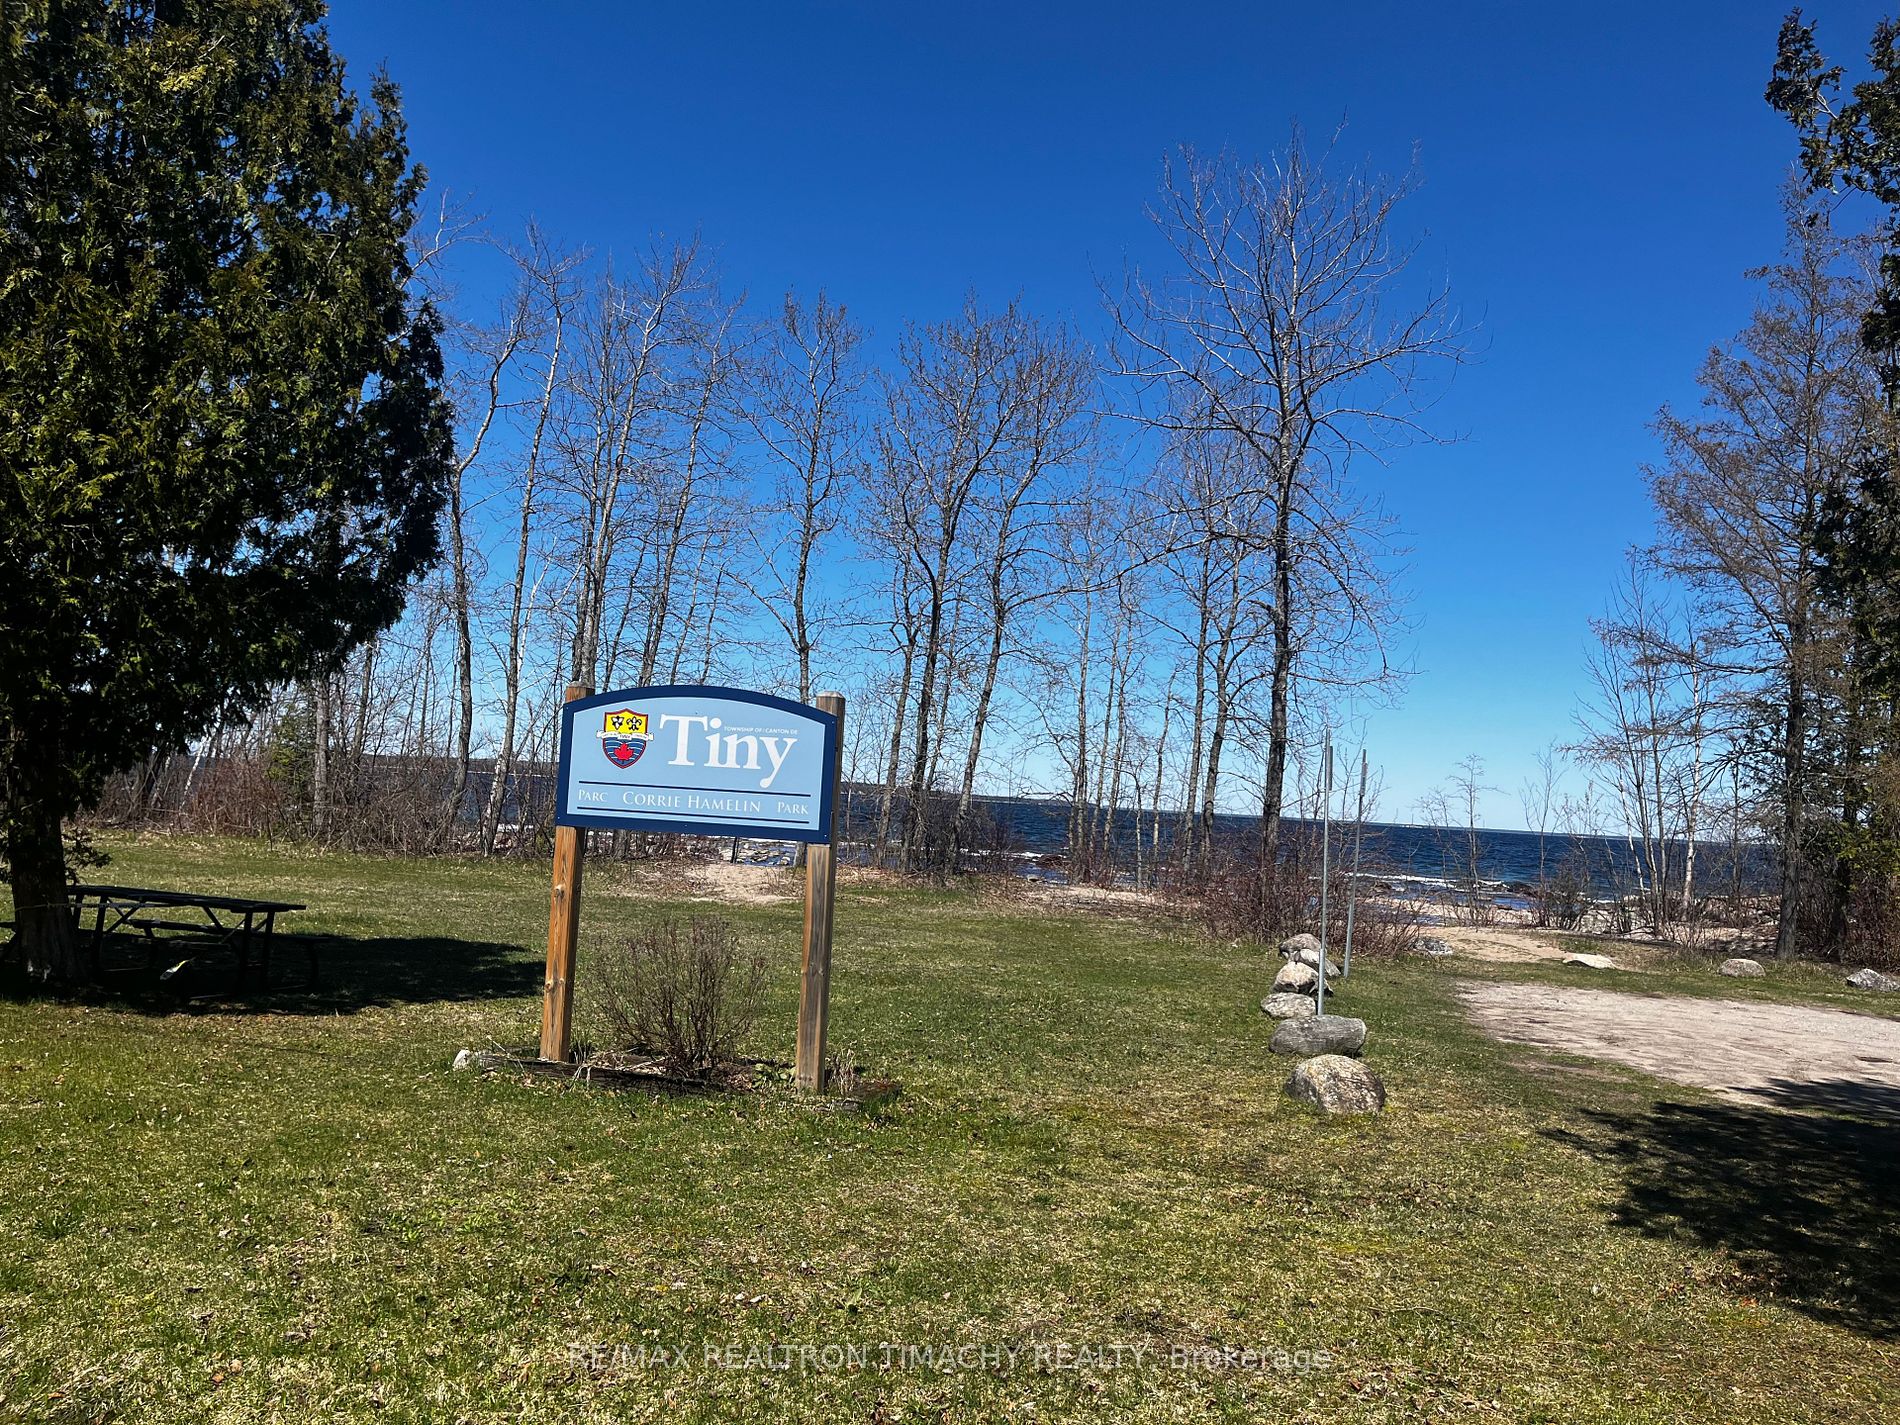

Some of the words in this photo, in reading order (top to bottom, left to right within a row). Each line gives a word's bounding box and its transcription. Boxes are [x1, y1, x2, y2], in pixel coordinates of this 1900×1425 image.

[659, 713, 798, 789] Tiny
[622, 791, 681, 808] CORRIE
[687, 795, 761, 813] HAMELIN
